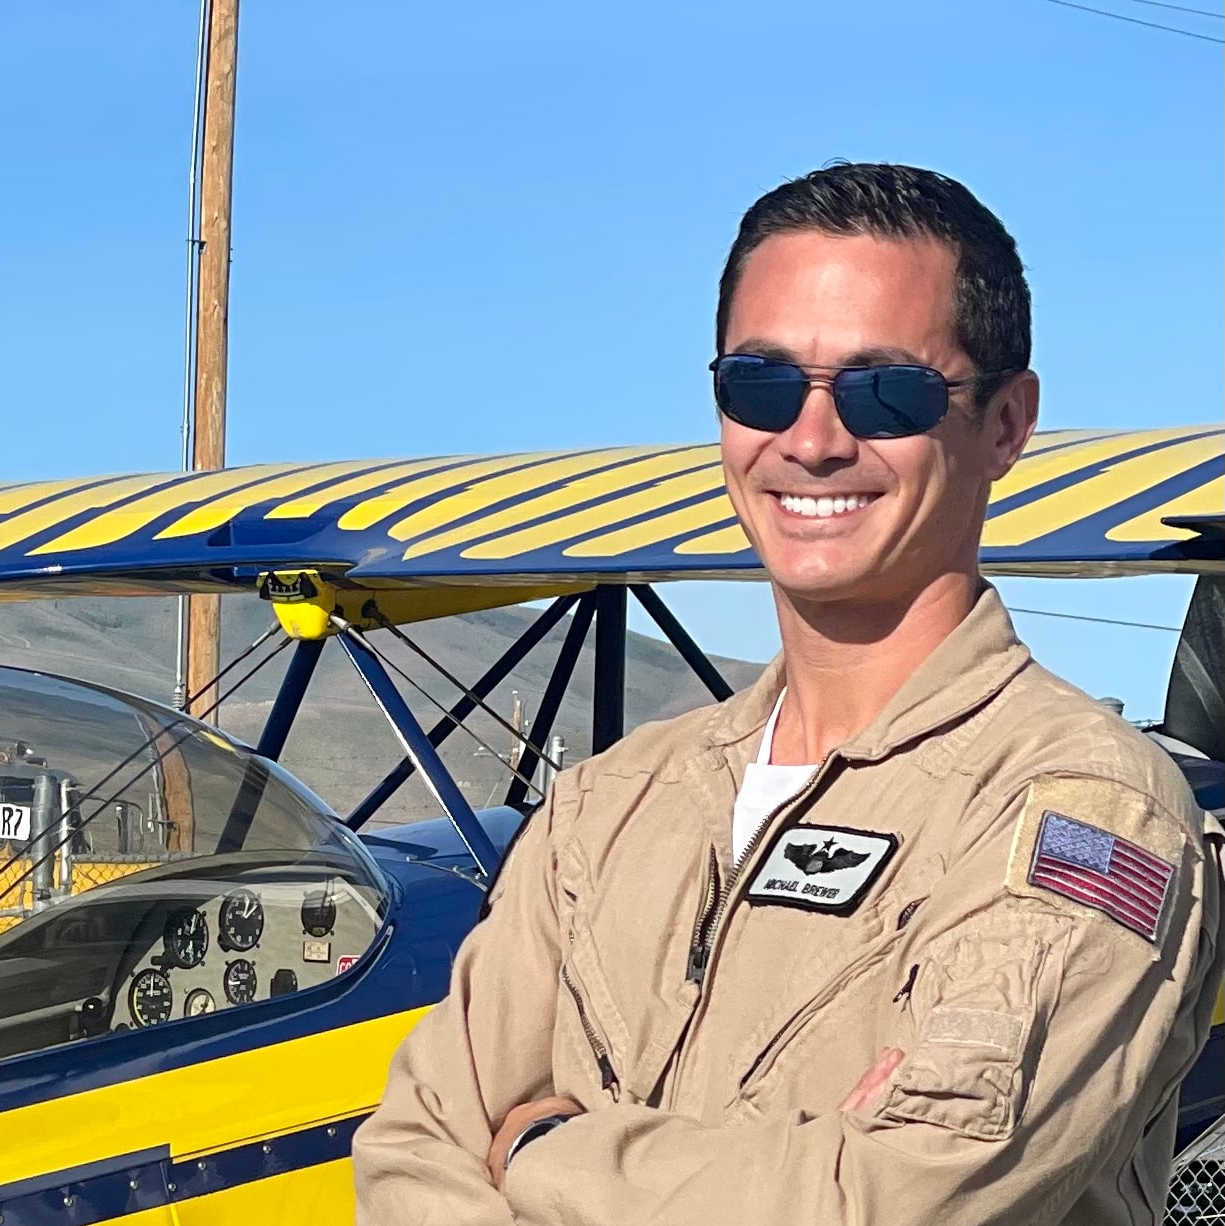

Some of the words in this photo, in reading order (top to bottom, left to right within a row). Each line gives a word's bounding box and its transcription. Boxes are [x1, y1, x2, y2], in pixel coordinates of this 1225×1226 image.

[1, 806, 23, 836] R7
[763, 878, 800, 893] MICHAEL
[801, 882, 841, 899] BREWER
